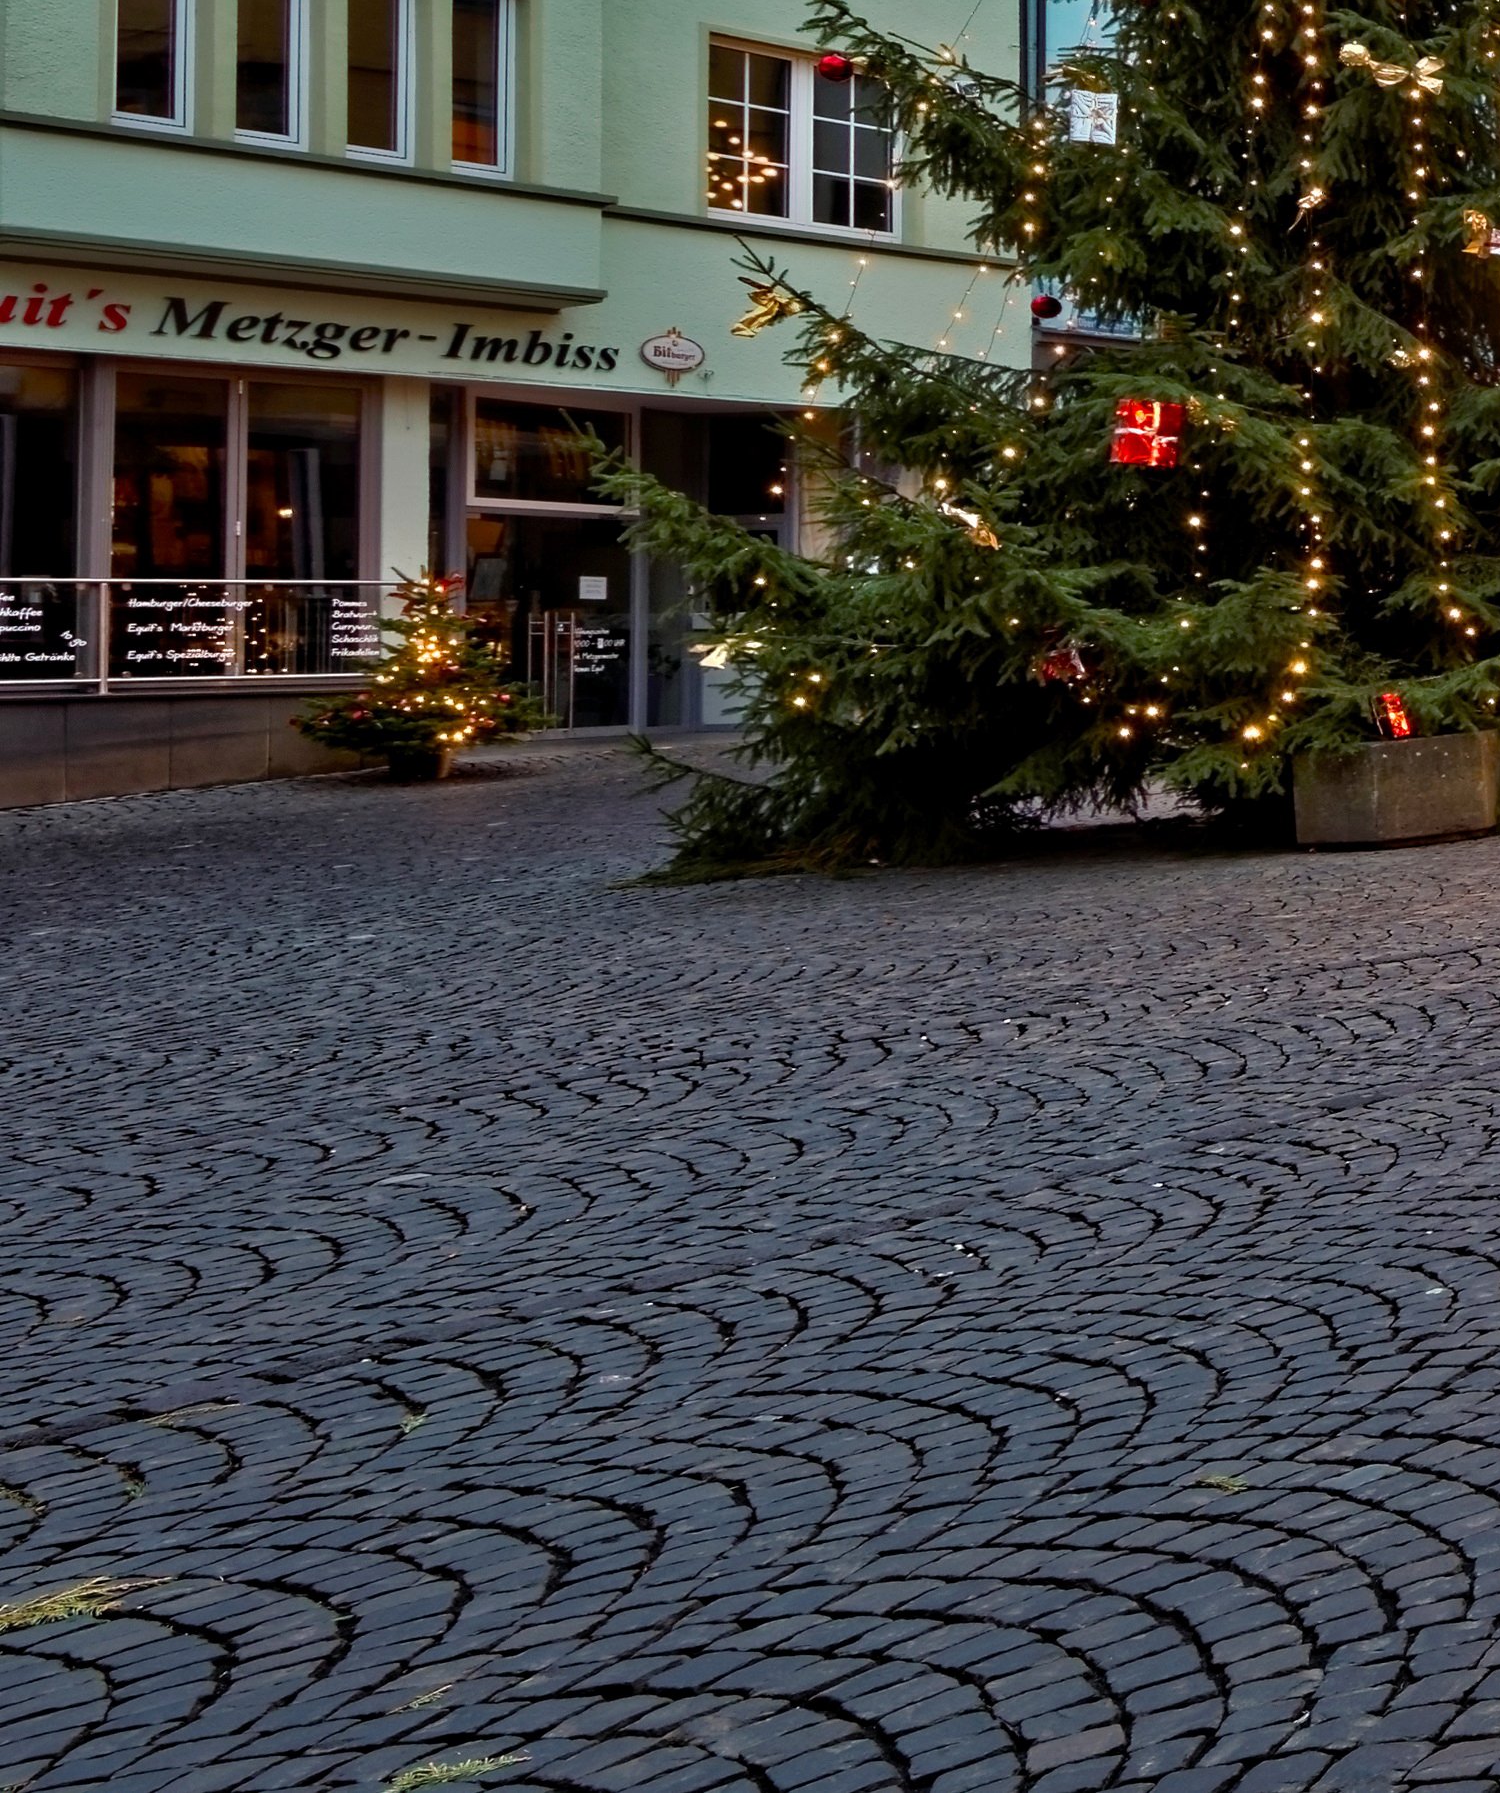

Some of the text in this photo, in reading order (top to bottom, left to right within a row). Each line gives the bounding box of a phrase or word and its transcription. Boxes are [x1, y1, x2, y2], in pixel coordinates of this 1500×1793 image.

[150, 296, 620, 372] Metzger-Imbiss
[127, 597, 254, 612] Hamburger/Cheeseburger
[25, 652, 76, 662] Getränke
[166, 649, 236, 663] Spezialburger
